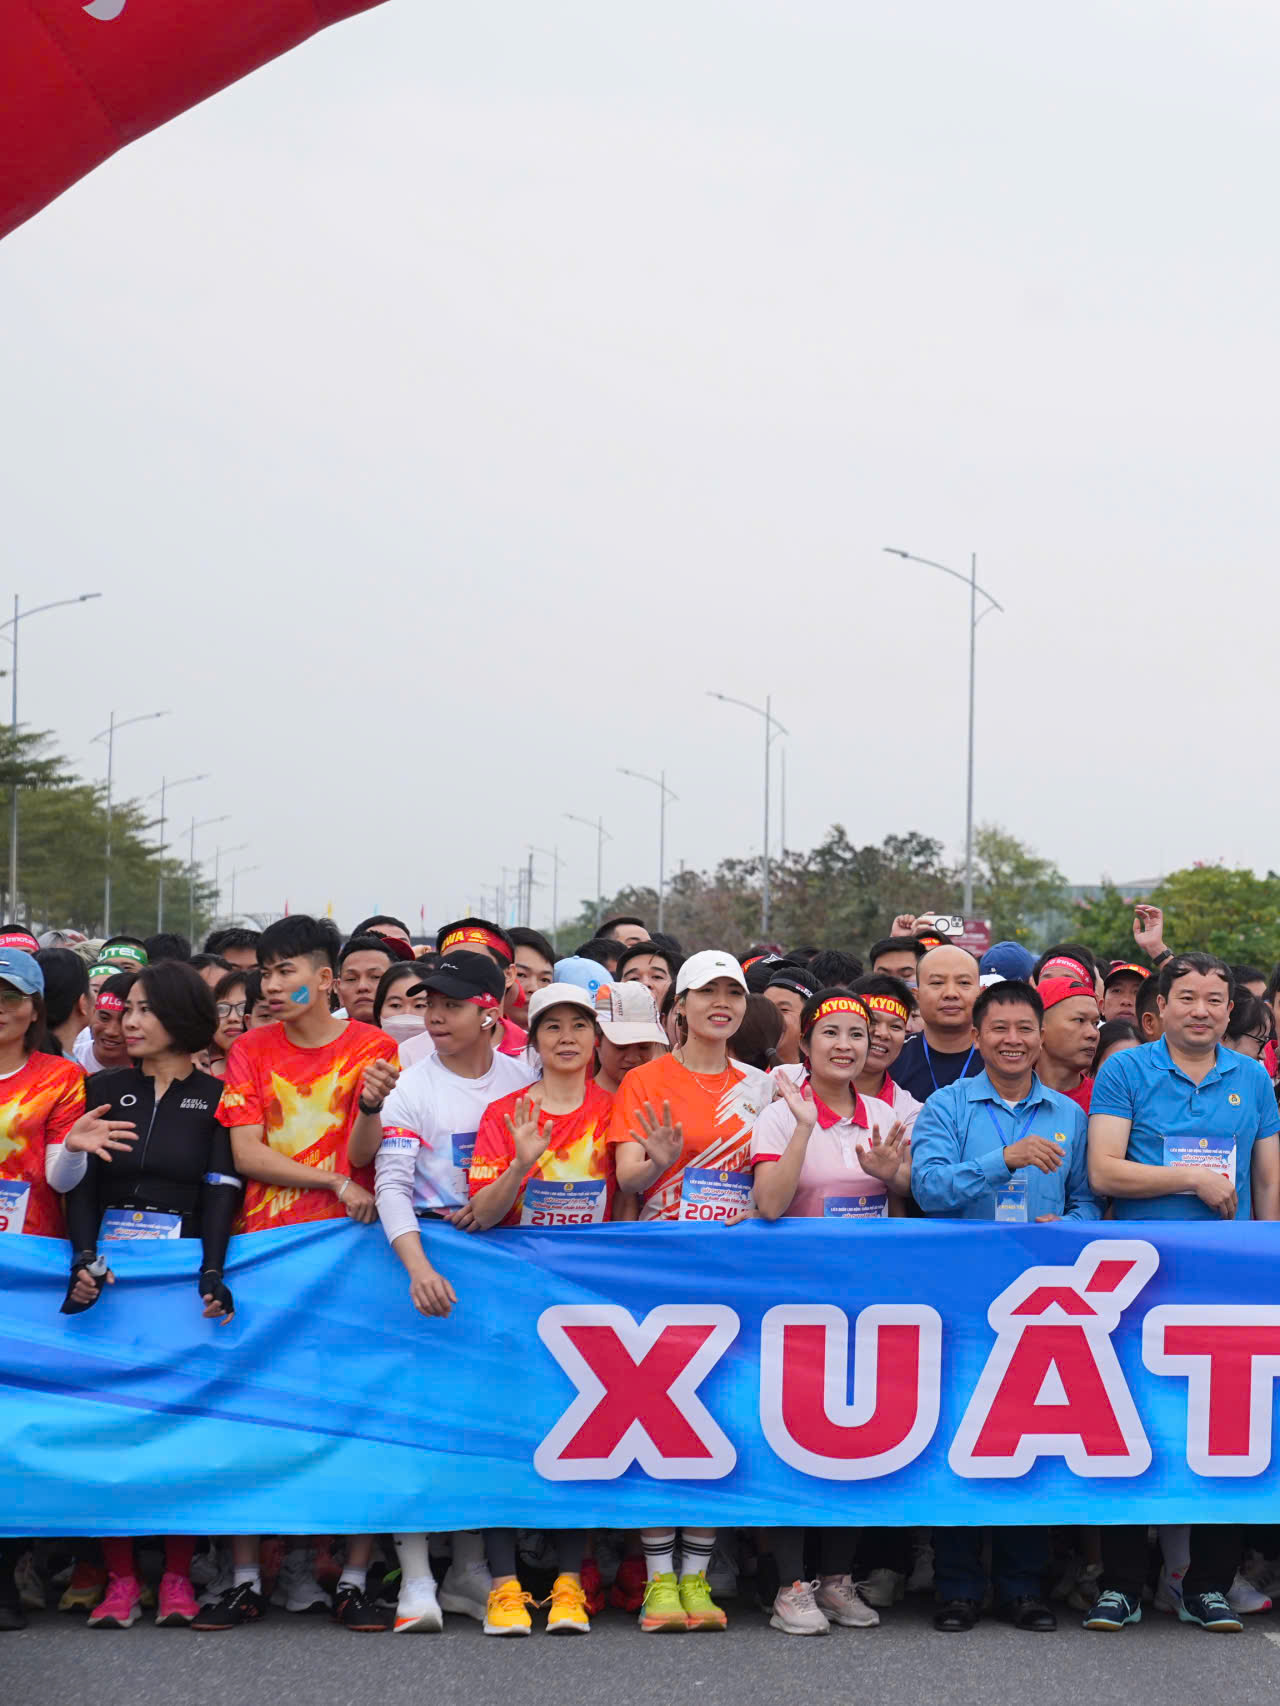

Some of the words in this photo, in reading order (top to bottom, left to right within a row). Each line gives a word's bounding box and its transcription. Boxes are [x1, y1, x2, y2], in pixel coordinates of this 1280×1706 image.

[108, 996, 122, 1006] LG
[821, 1000, 867, 1018] KYOWA
[685, 1203, 749, 1221] 2024
